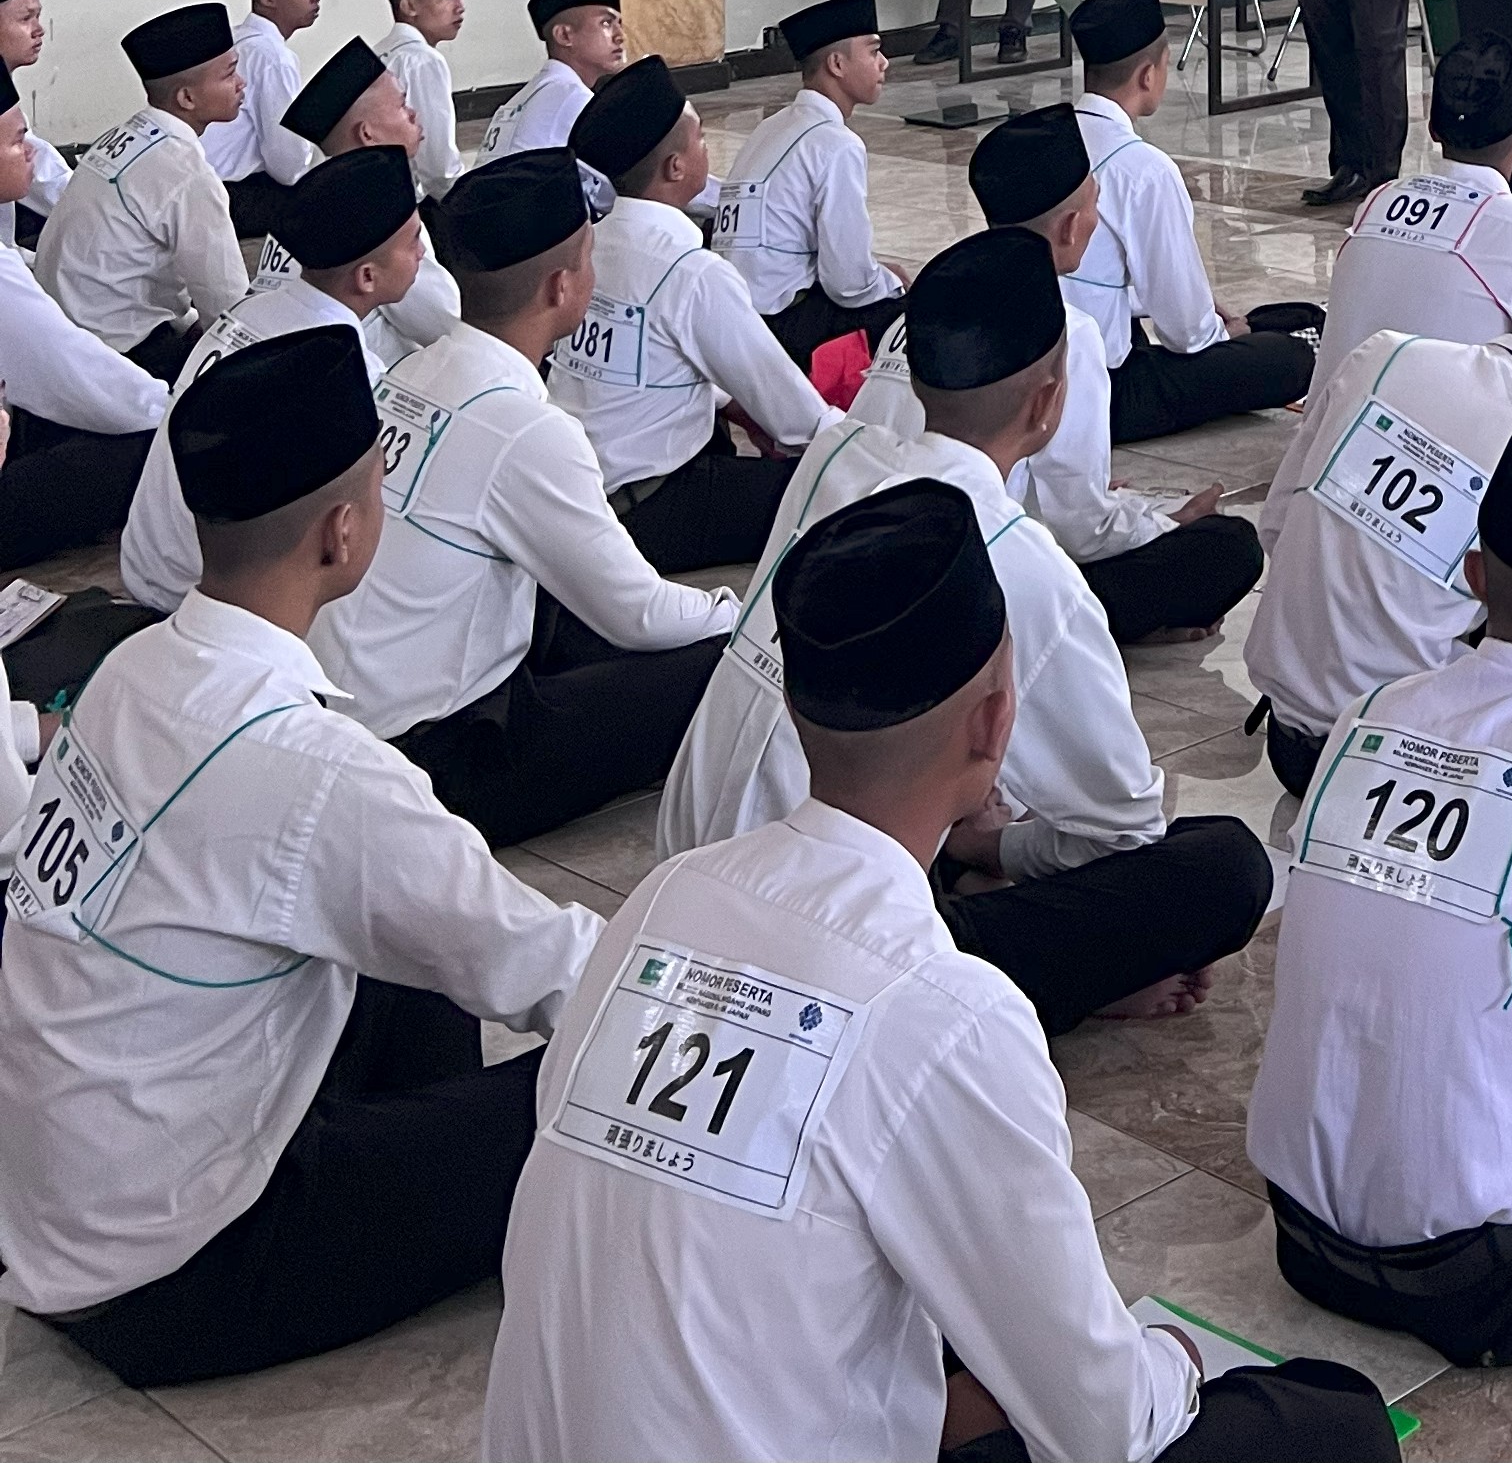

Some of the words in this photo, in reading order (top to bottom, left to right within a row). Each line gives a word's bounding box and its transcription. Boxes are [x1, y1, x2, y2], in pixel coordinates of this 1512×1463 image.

[96, 126, 135, 159] 045
[1386, 194, 1450, 230] 091
[571, 318, 614, 363] 081
[1364, 455, 1443, 535] 102
[1399, 738, 1438, 760] NOMOR
[1438, 750, 1480, 768] PESERTA
[1363, 779, 1470, 862] 120
[24, 797, 89, 906] 105
[685, 967, 724, 990] NOMOR
[626, 1022, 755, 1135] 121
